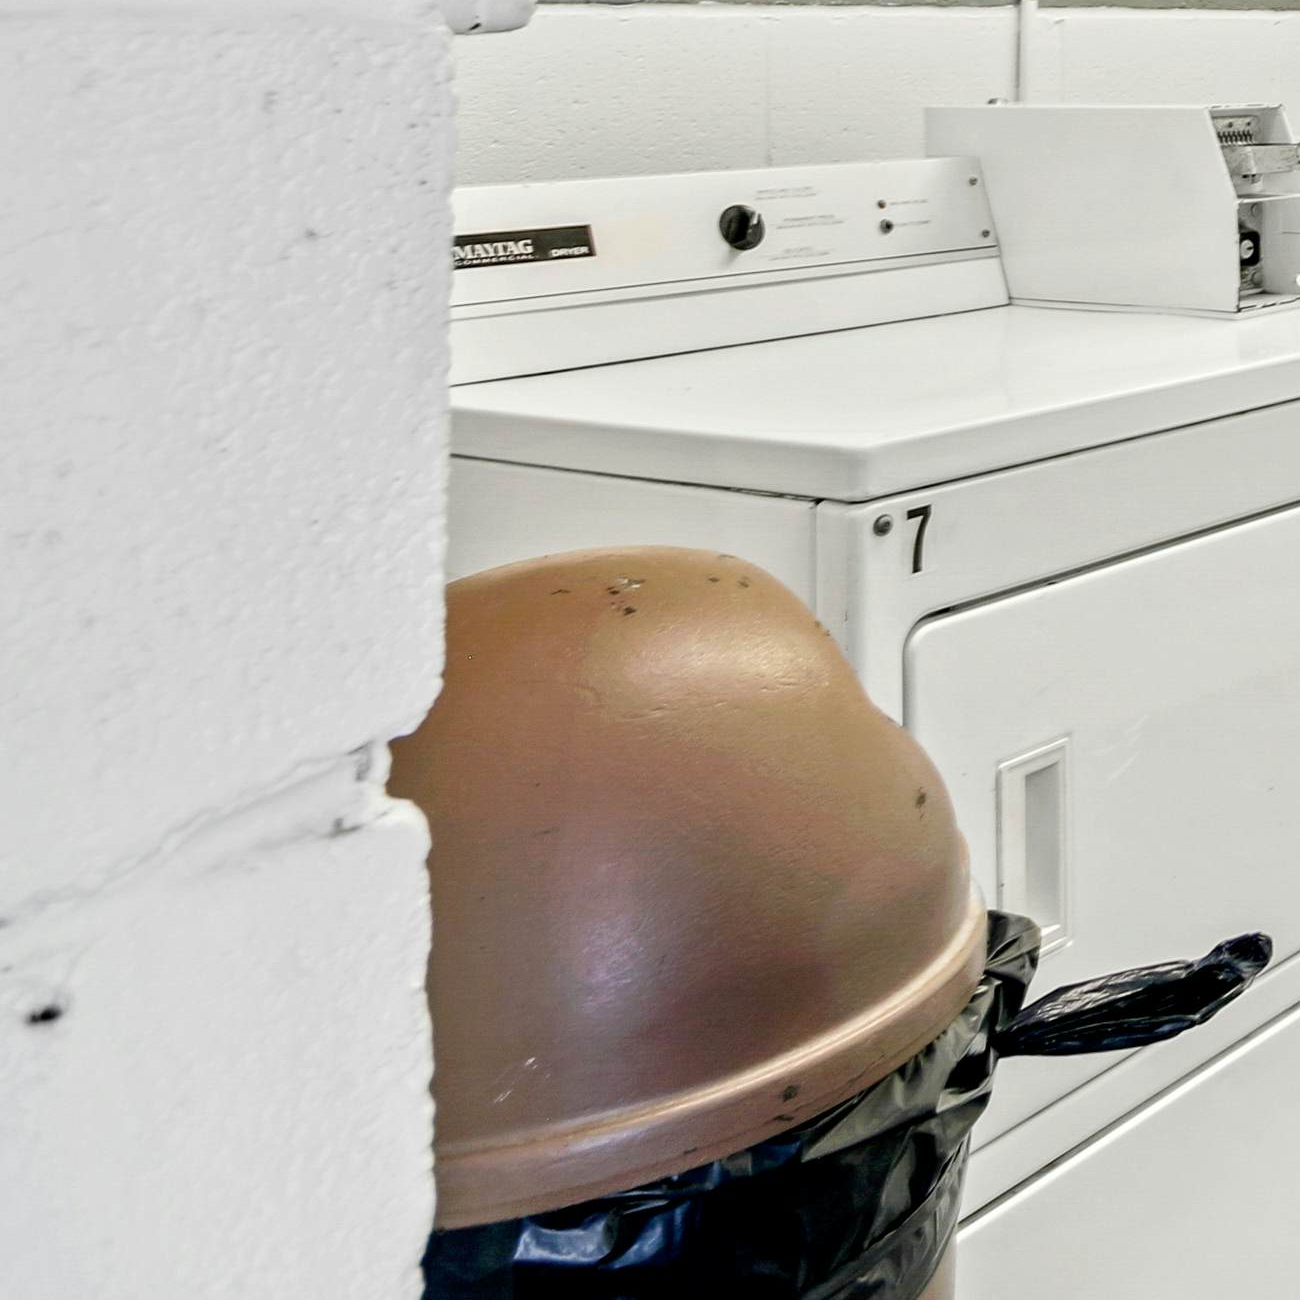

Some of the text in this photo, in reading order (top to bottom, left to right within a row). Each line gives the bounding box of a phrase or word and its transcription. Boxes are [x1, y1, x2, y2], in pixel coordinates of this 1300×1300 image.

[452, 239, 590, 261] MAYTAG DRYER
[906, 504, 932, 573] 7
